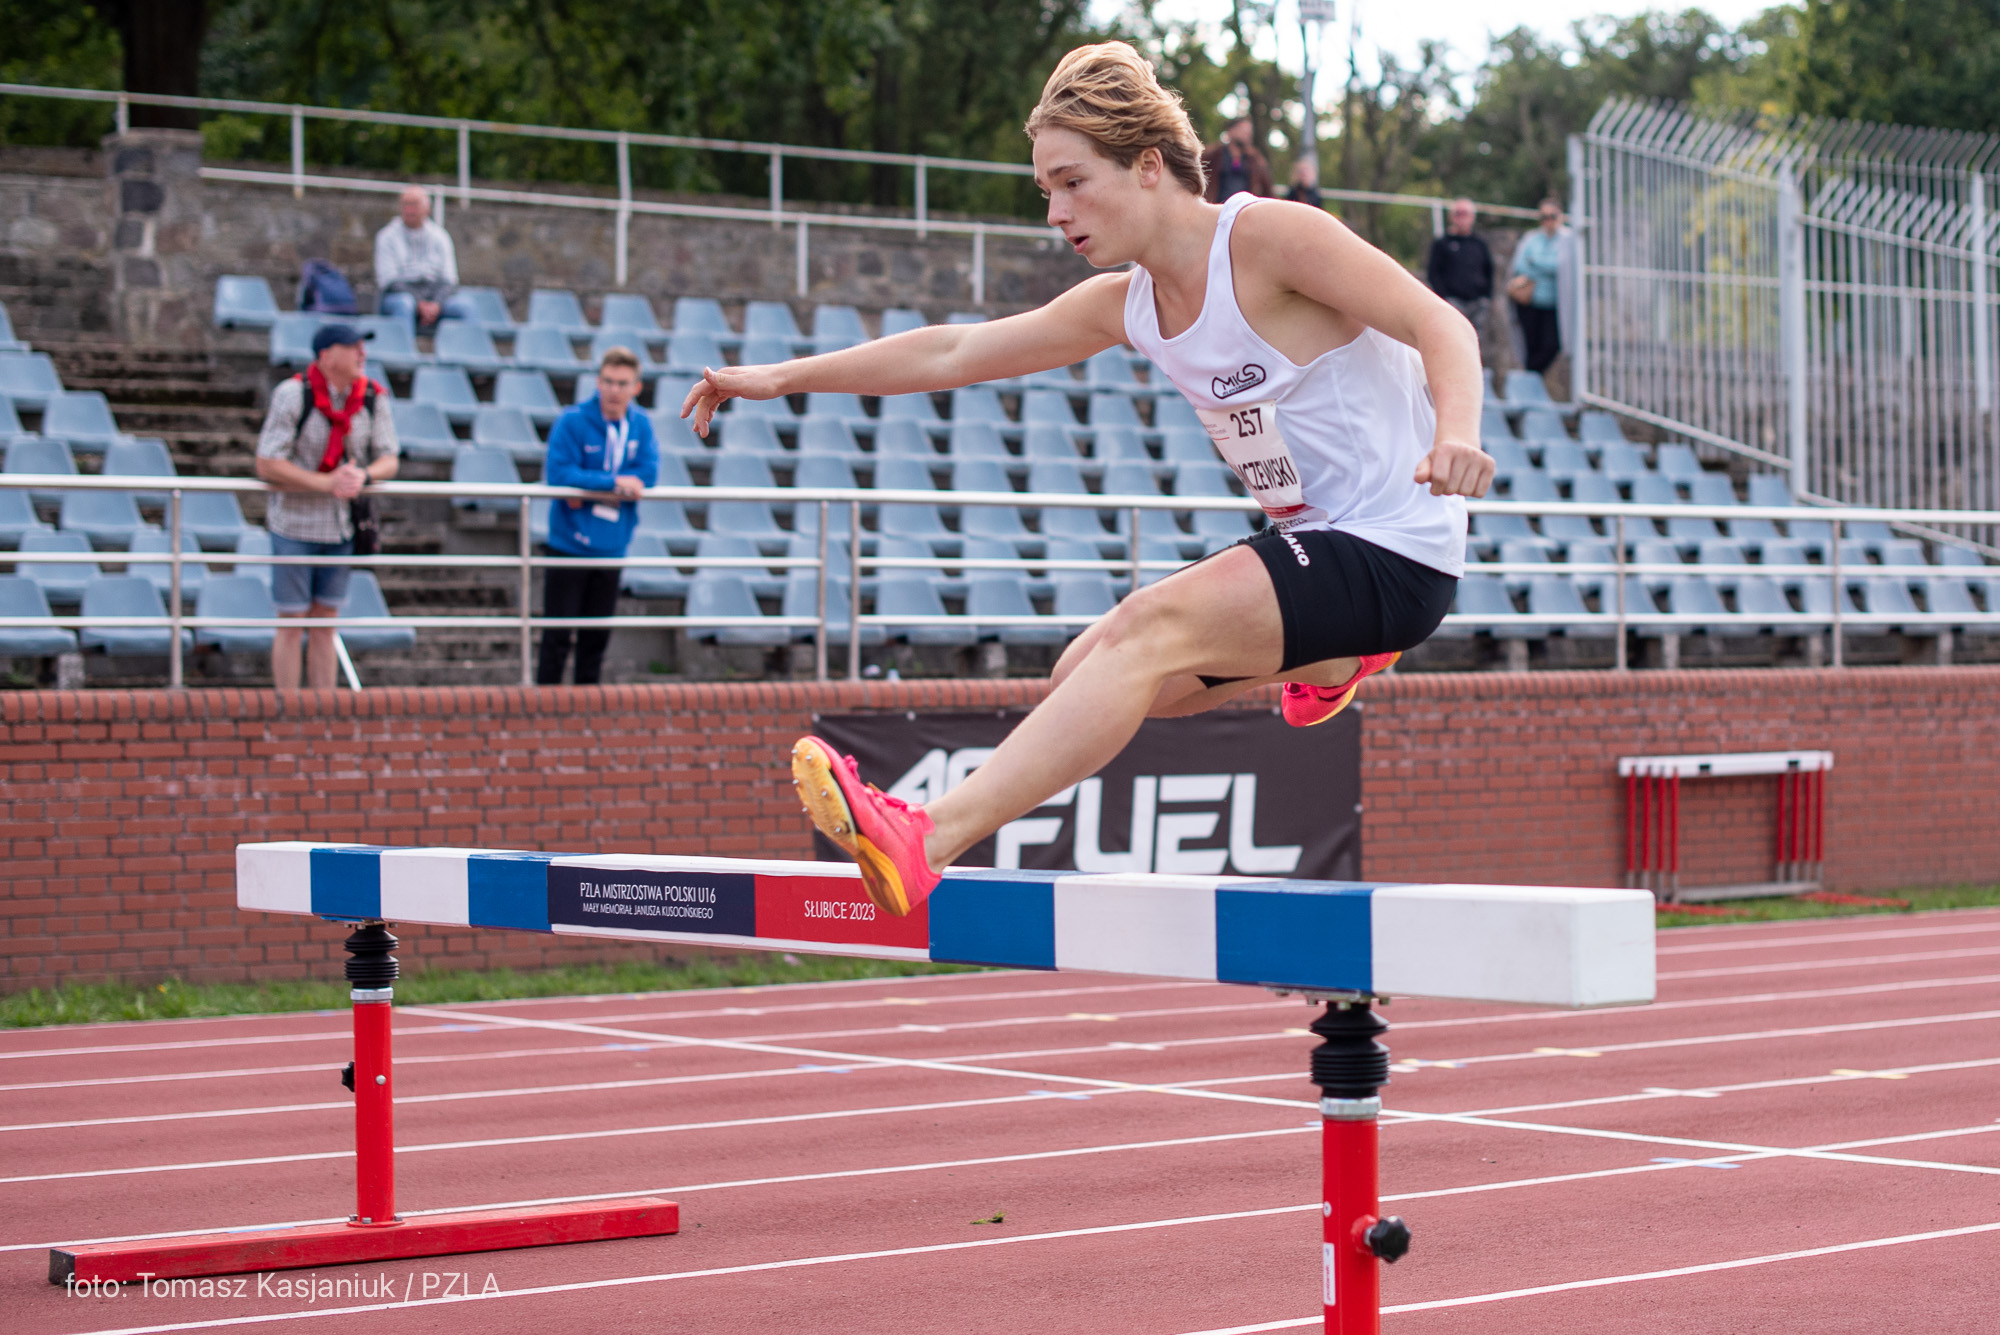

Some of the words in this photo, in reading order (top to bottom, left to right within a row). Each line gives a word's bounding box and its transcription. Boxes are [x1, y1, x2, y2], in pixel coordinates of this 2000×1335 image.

[1230, 407, 1263, 437] 257
[1280, 534, 1310, 567] JAKO
[994, 773, 1303, 875] FUEL
[580, 882, 601, 898] PZLA
[602, 884, 663, 901] MISTRZOSTWA
[664, 885, 696, 902] POLSKI
[698, 887, 717, 903] U16
[582, 902, 599, 913] MAŁY
[600, 903, 632, 915] MEMORIAŁ
[633, 905, 661, 916] JANUSZA
[661, 904, 714, 919] KUSOCIŃSKIEGO
[804, 899, 848, 919] SŁUBICE
[849, 902, 876, 921] 2023
